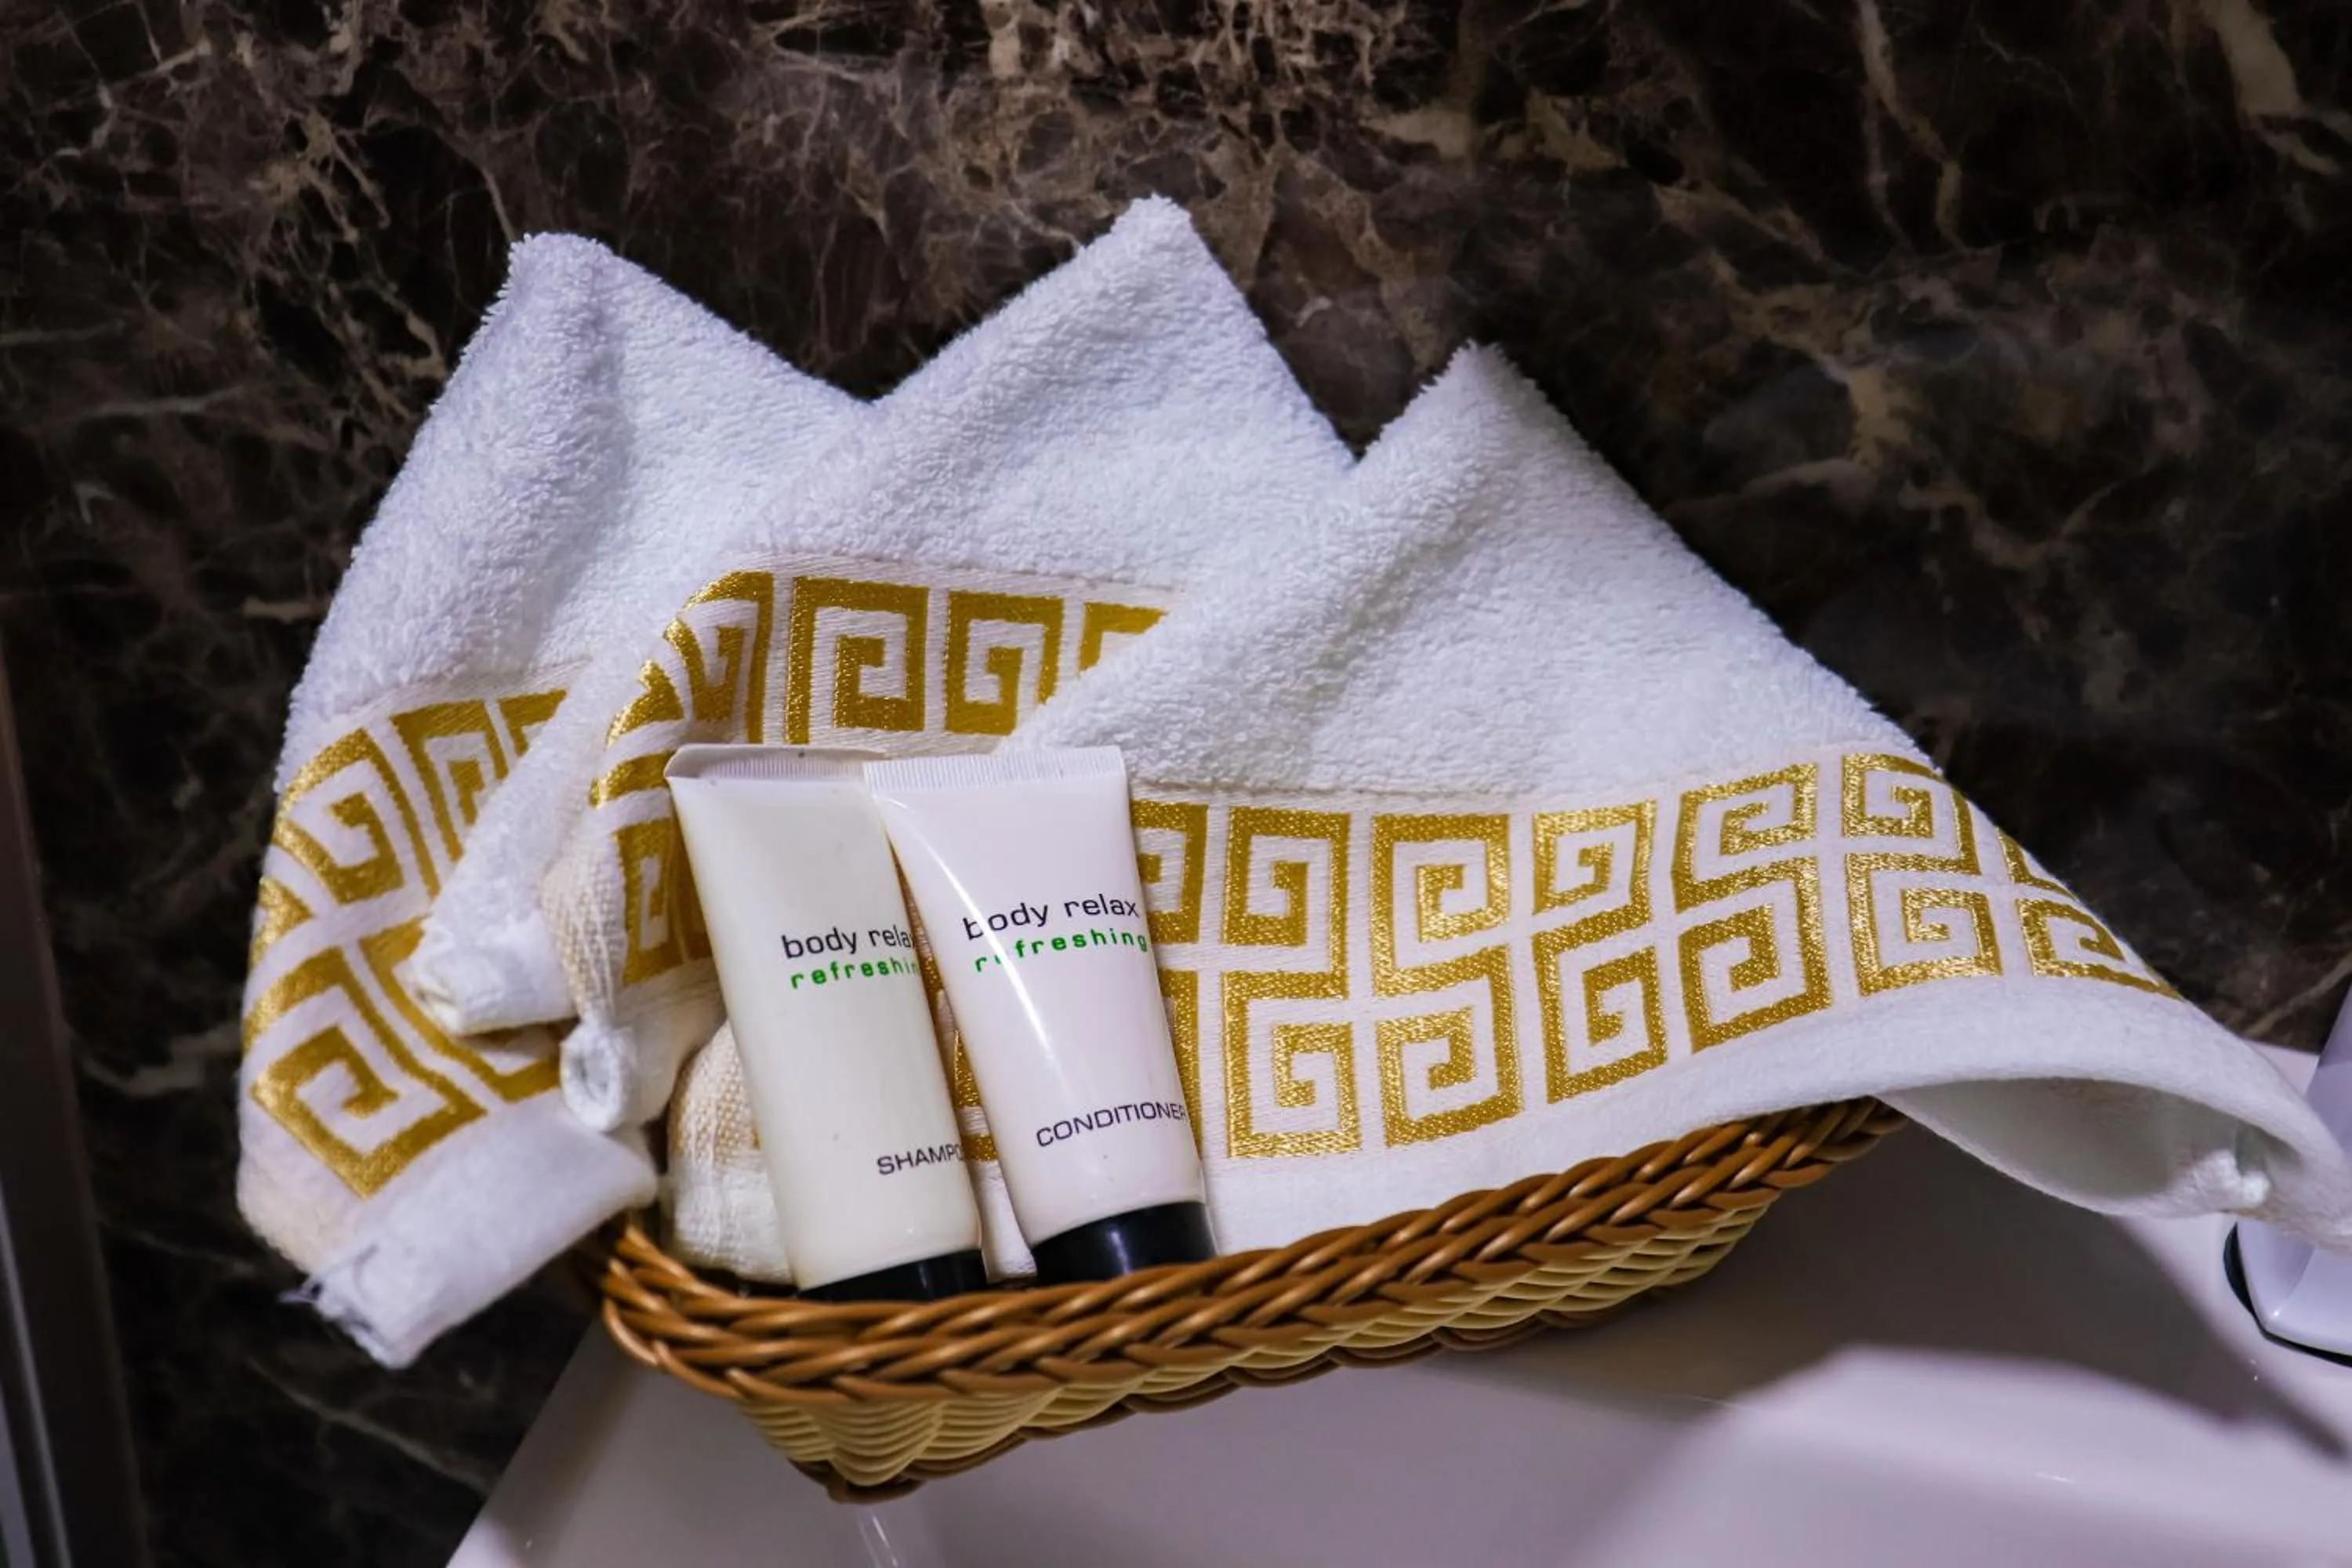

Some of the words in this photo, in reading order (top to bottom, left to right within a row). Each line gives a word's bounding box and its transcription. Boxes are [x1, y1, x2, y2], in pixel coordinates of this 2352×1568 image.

[963, 902, 1048, 940] body
[1064, 893, 1140, 918] relax
[782, 926, 857, 958] body
[868, 924, 915, 947] rela
[790, 956, 920, 989] refreshin
[877, 1143, 964, 1175] SHAMPO
